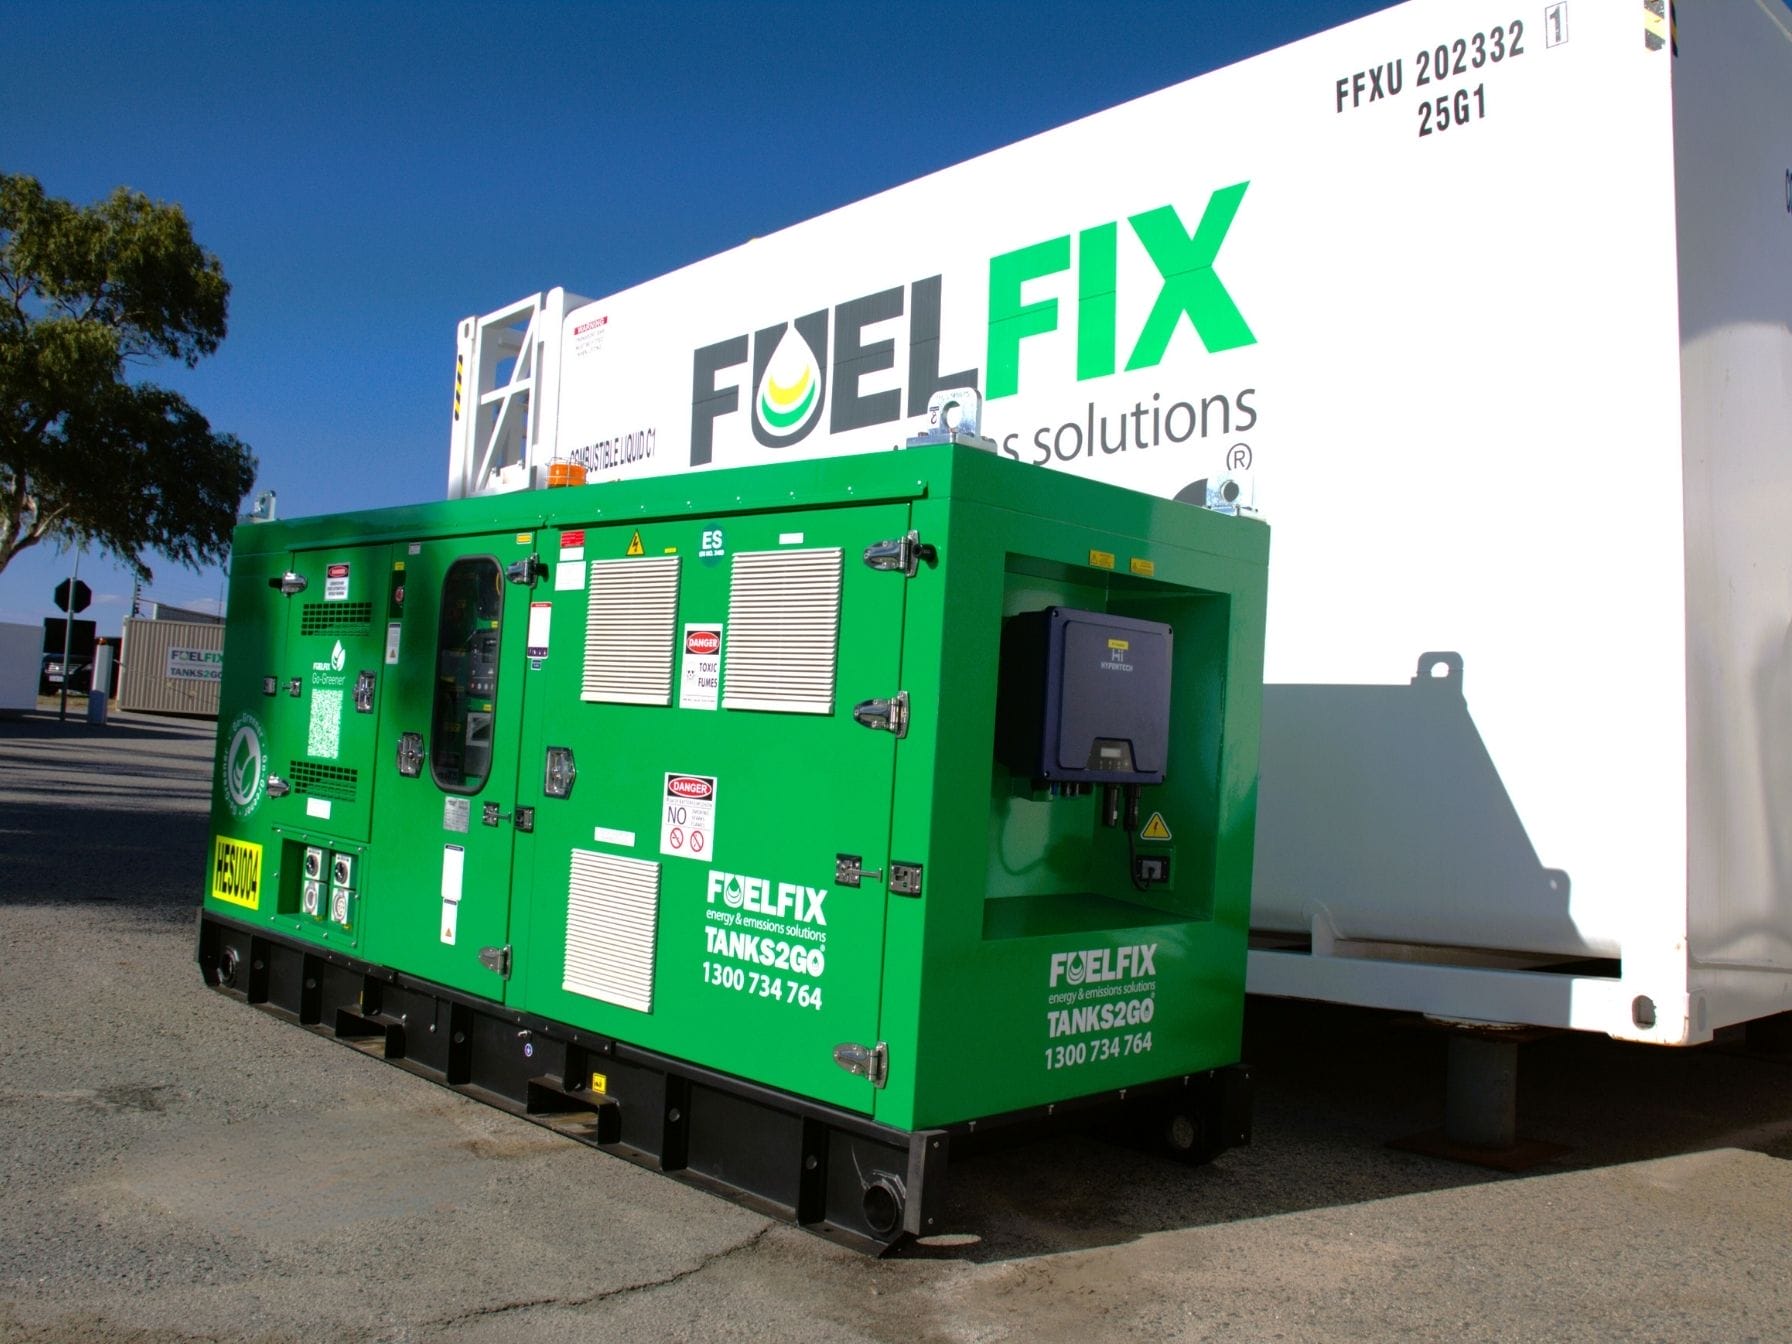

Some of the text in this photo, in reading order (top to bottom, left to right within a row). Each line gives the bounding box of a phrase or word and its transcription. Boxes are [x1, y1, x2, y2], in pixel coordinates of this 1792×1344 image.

[1336, 5, 1562, 114] FFXU 202332 1
[1418, 83, 1485, 138] 25G1
[690, 180, 1258, 467] FUELFIX
[620, 430, 645, 464] LIQUID
[646, 427, 656, 459] C1
[1033, 388, 1257, 467] solutions
[702, 530, 723, 549] ES
[688, 638, 718, 648] DANGER
[312, 673, 346, 685] Go-Greener
[698, 677, 717, 688] FUMES
[699, 663, 717, 673] TOXIC
[673, 781, 708, 794] DANGER
[667, 805, 687, 825] NO
[215, 841, 259, 902] HESU004
[707, 869, 828, 926] FUELFIX
[706, 909, 827, 943] energy & emissions solutions
[1049, 943, 1158, 988] FUELFIX
[703, 961, 823, 1011] 1300 734 764
[1048, 981, 1156, 1005] energy & emissions solutions
[1045, 1031, 1153, 1070] 1300 734 764
